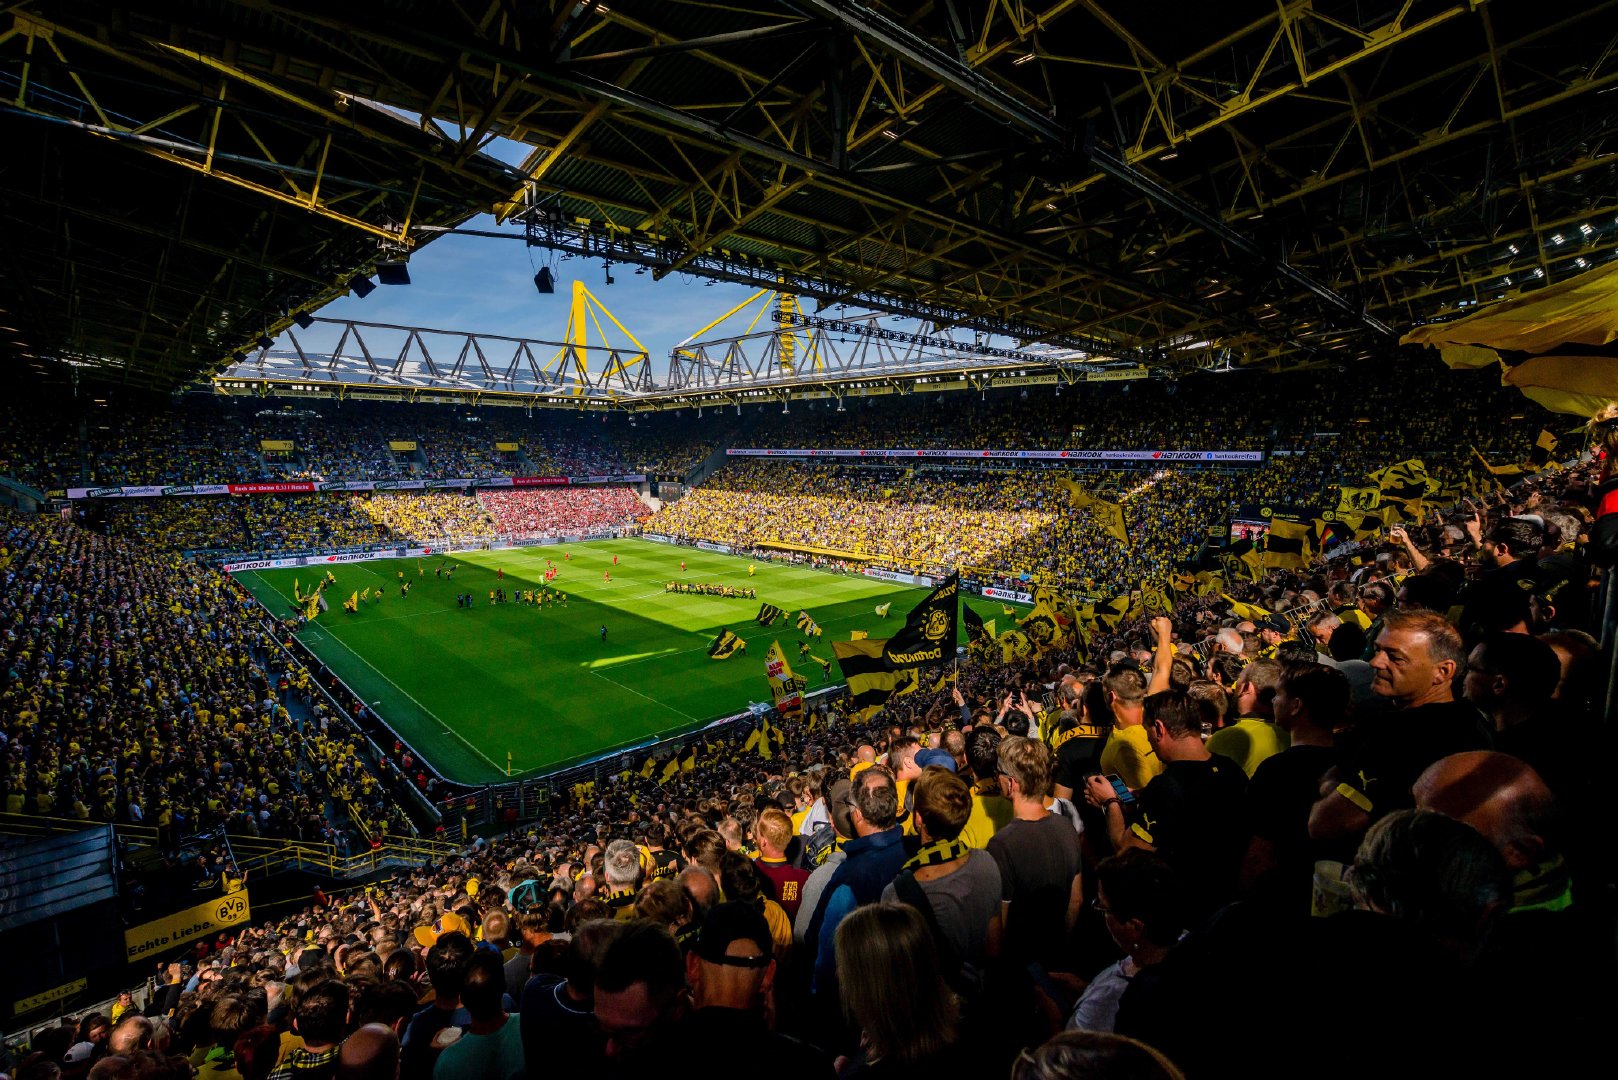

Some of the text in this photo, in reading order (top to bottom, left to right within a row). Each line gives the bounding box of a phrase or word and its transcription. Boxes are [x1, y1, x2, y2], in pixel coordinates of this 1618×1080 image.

[336, 552, 375, 561] HANKOOK
[229, 560, 271, 572] HANKOOK
[992, 589, 1027, 601] HANKOOK
[219, 899, 244, 919] BVB
[128, 921, 215, 957] Echte Liebe.
